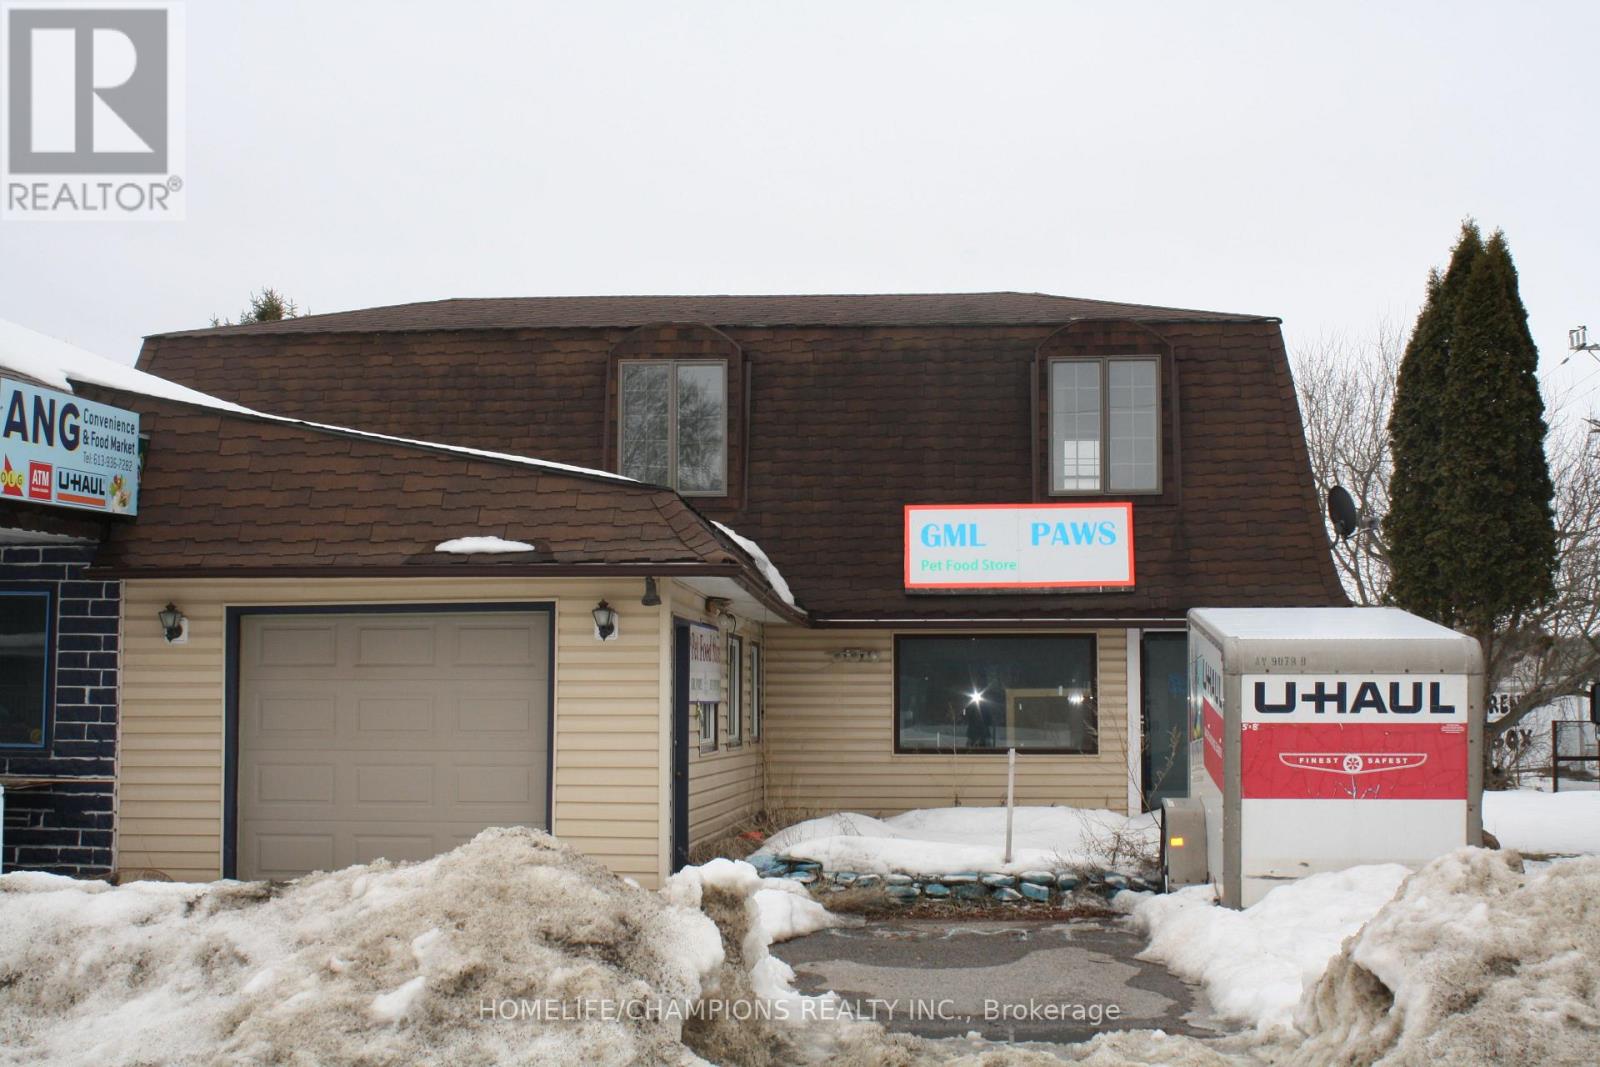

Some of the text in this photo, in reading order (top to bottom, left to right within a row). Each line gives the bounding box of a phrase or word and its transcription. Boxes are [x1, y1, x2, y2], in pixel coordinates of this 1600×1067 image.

[83, 408, 135, 435] Convenience
[83, 429, 135, 455] & Food Market
[32, 469, 50, 486] ATM
[920, 521, 1117, 547] GML PAWS
[921, 559, 1017, 571] Pet Food Store
